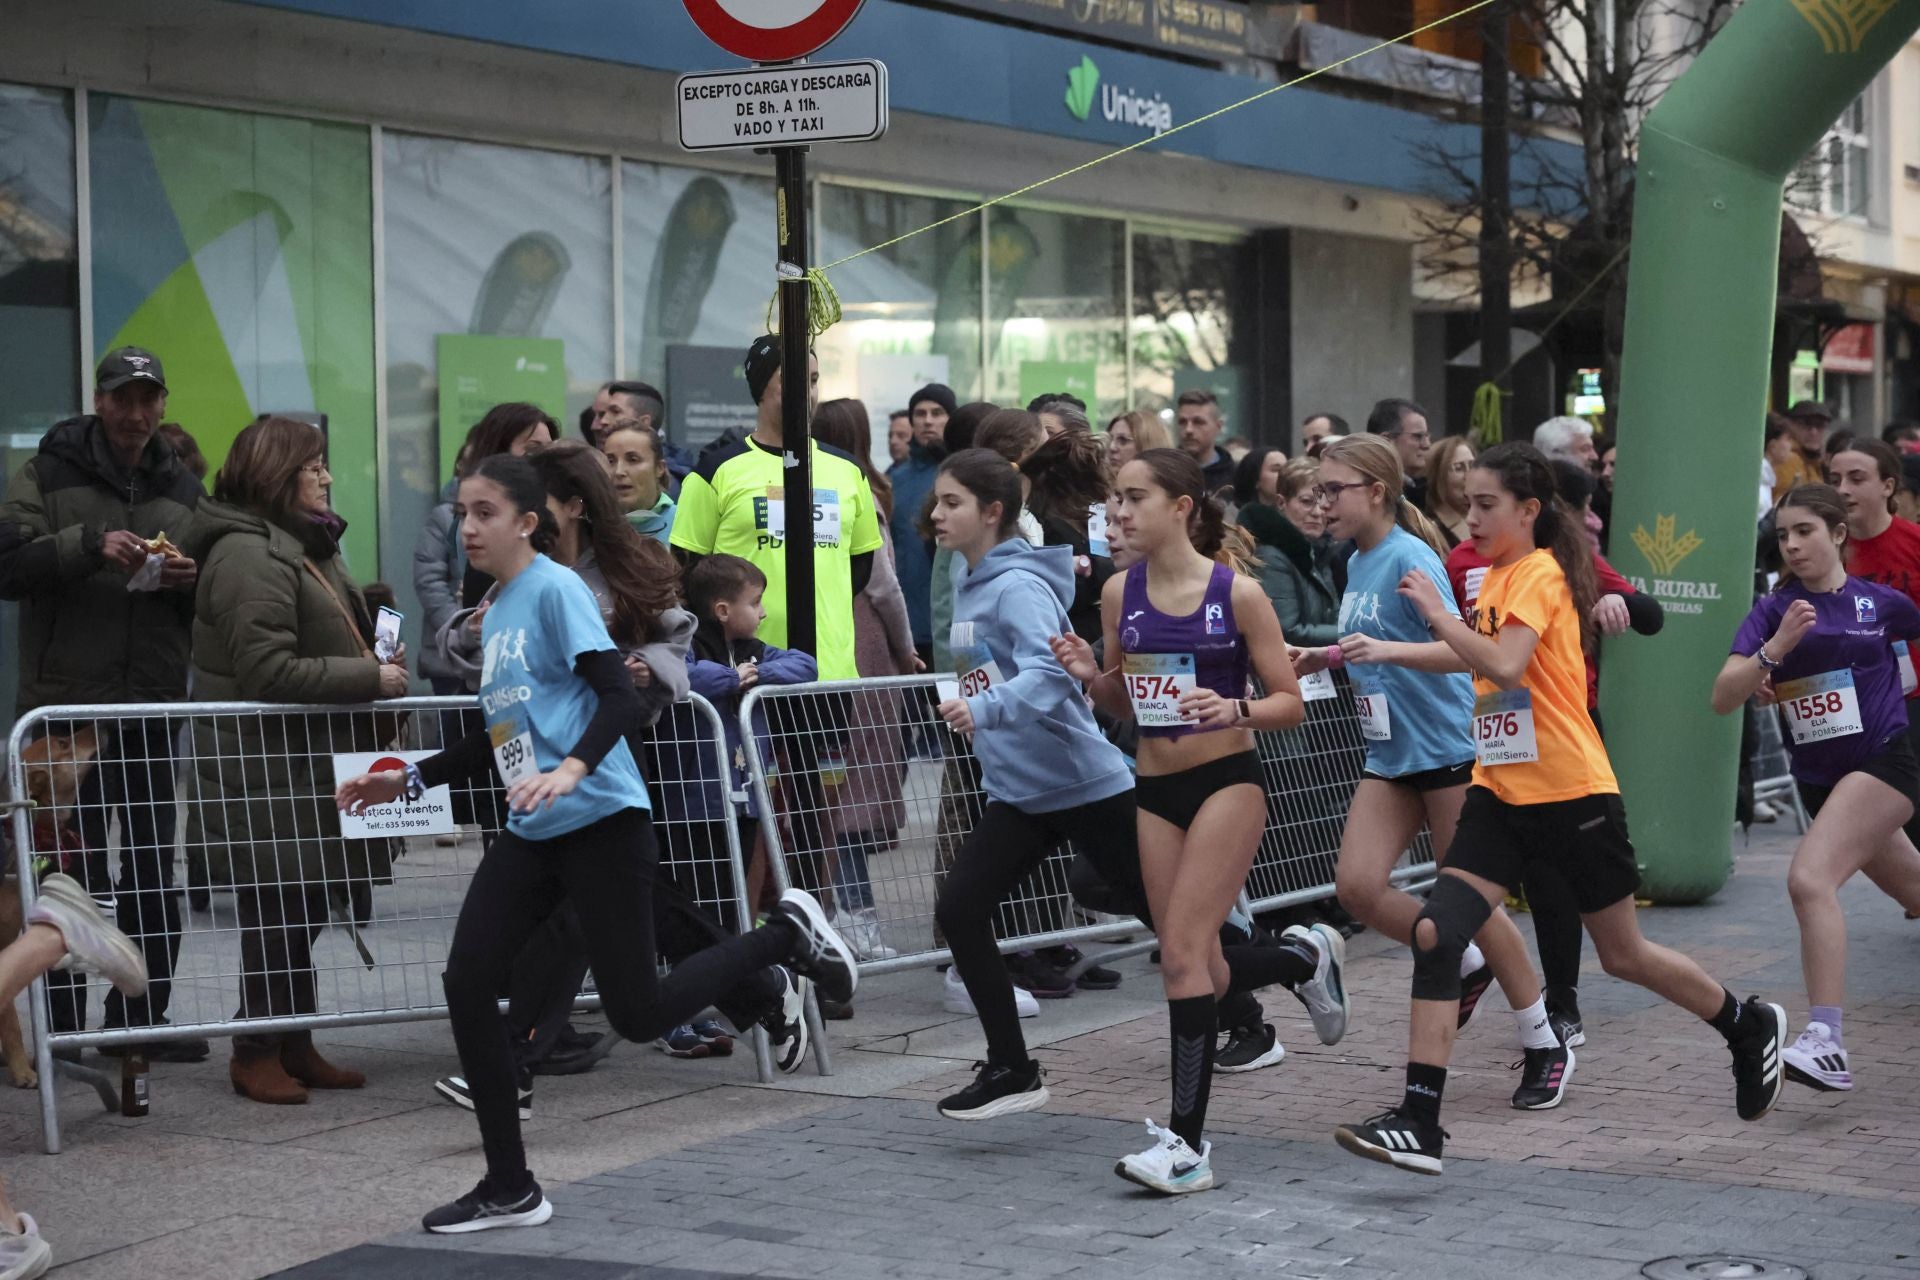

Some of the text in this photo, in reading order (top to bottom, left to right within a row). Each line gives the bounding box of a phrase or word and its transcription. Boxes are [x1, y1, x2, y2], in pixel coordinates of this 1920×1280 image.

[684, 72, 872, 100] EXCEPTO CARGA Y DESCARGA
[736, 98, 820, 116] DE 8h. A 11h.
[1102, 84, 1172, 135] Unicaja
[734, 117, 824, 136] VADO Y TAXI
[1653, 579, 1722, 599] RURAL
[1128, 676, 1180, 699] 1574
[1138, 701, 1168, 710] BIANCA
[1790, 691, 1843, 720] 1558
[1477, 712, 1519, 740] 1576
[1811, 717, 1827, 727] ELIA
[1812, 724, 1854, 738] PDMSiero
[501, 738, 524, 770] 999
[1486, 751, 1529, 761] PDMSiero
[394, 807, 402, 819] y
[404, 803, 444, 815] eventos
[366, 819, 430, 830] Telf.: 635 590 995
